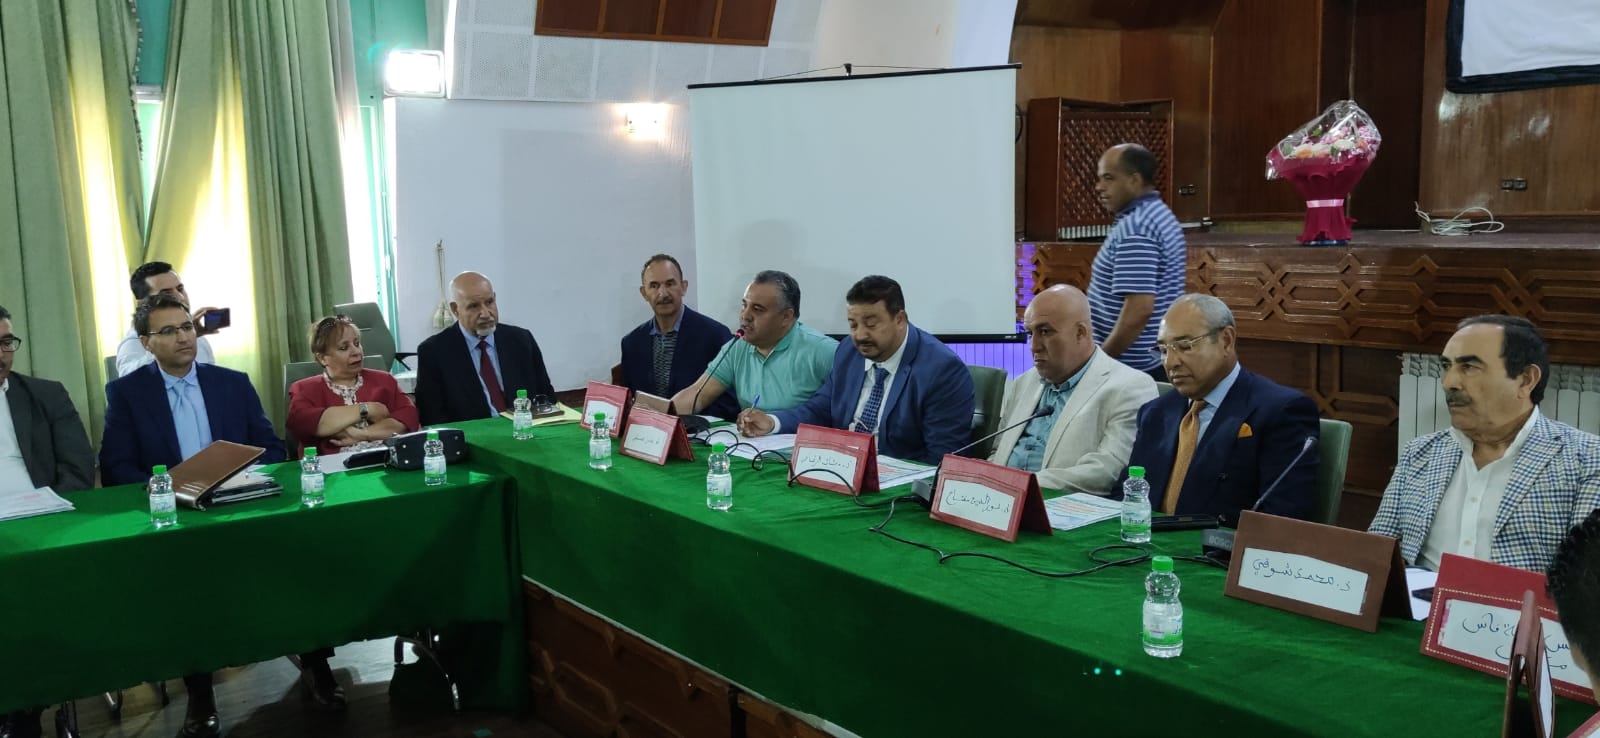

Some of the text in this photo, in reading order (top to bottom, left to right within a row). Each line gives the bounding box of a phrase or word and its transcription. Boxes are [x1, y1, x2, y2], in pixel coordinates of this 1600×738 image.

[945, 488, 970, 506] مفتاح
[1293, 568, 1335, 585] محمد
[1462, 612, 1499, 634] فاس
